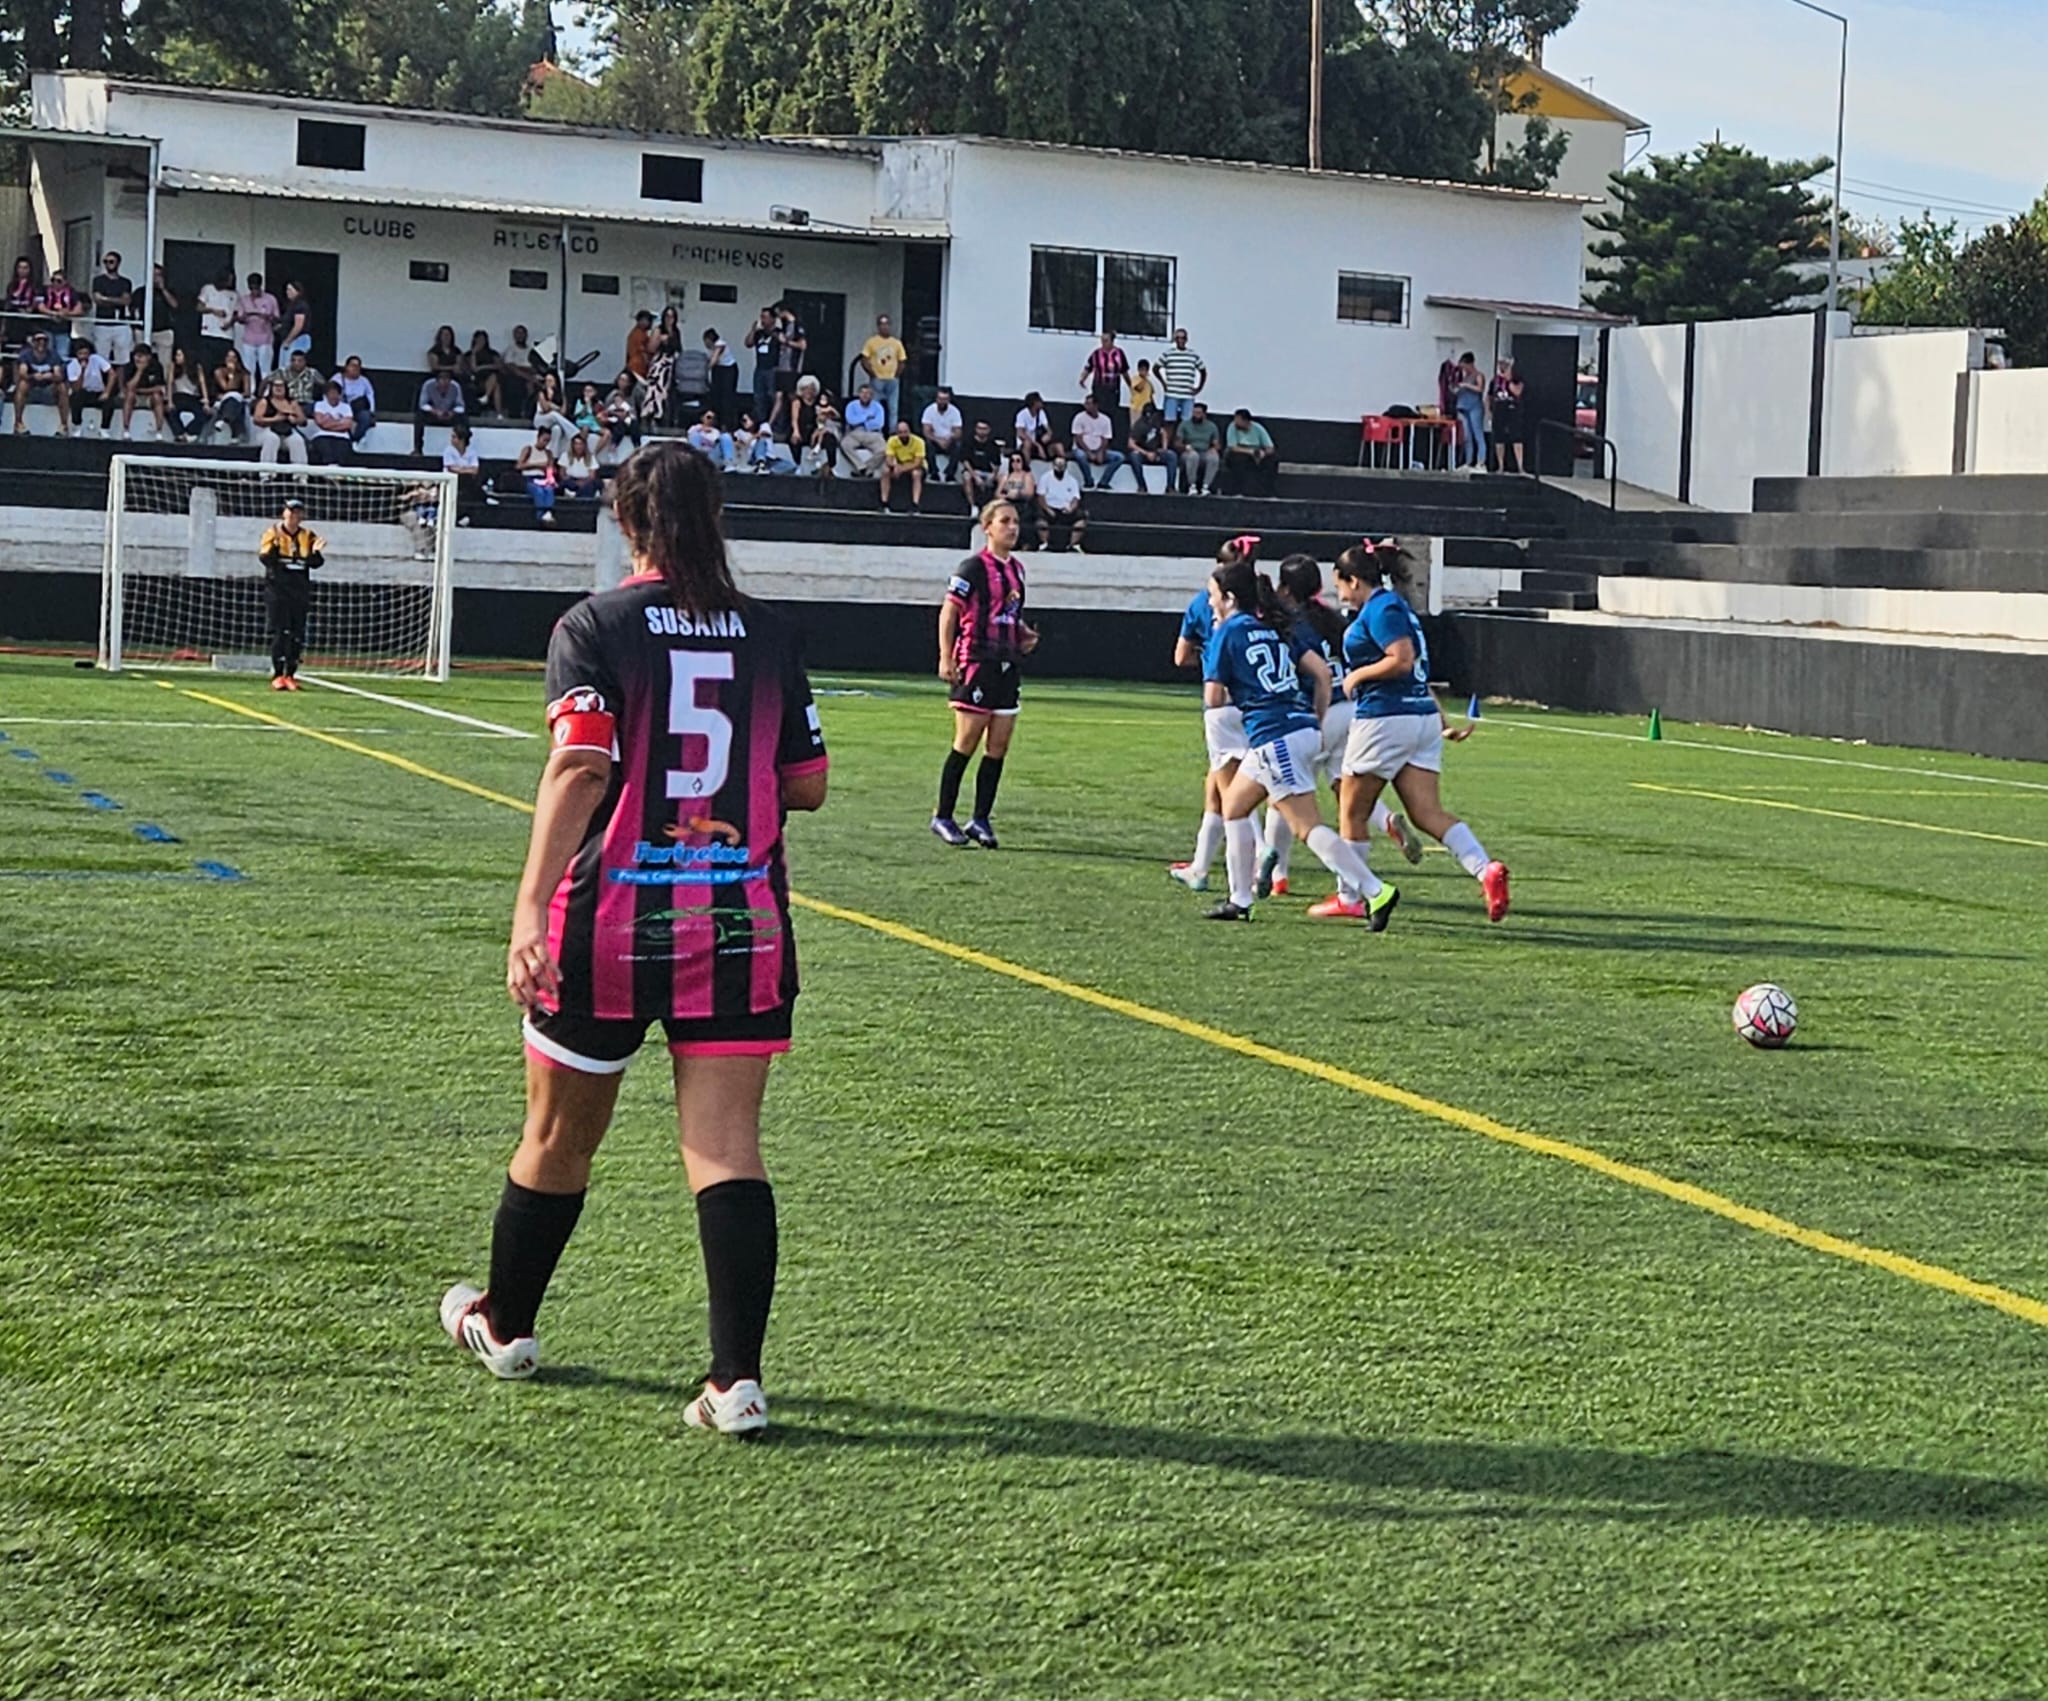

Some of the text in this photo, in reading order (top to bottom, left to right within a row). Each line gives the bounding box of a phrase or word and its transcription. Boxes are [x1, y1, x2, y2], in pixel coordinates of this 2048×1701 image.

[343, 217, 416, 240] CLUBE
[493, 229, 599, 255] ATLETCO
[644, 605, 747, 638] SUSANA
[1245, 642, 1300, 694] 24
[665, 649, 735, 798] 5
